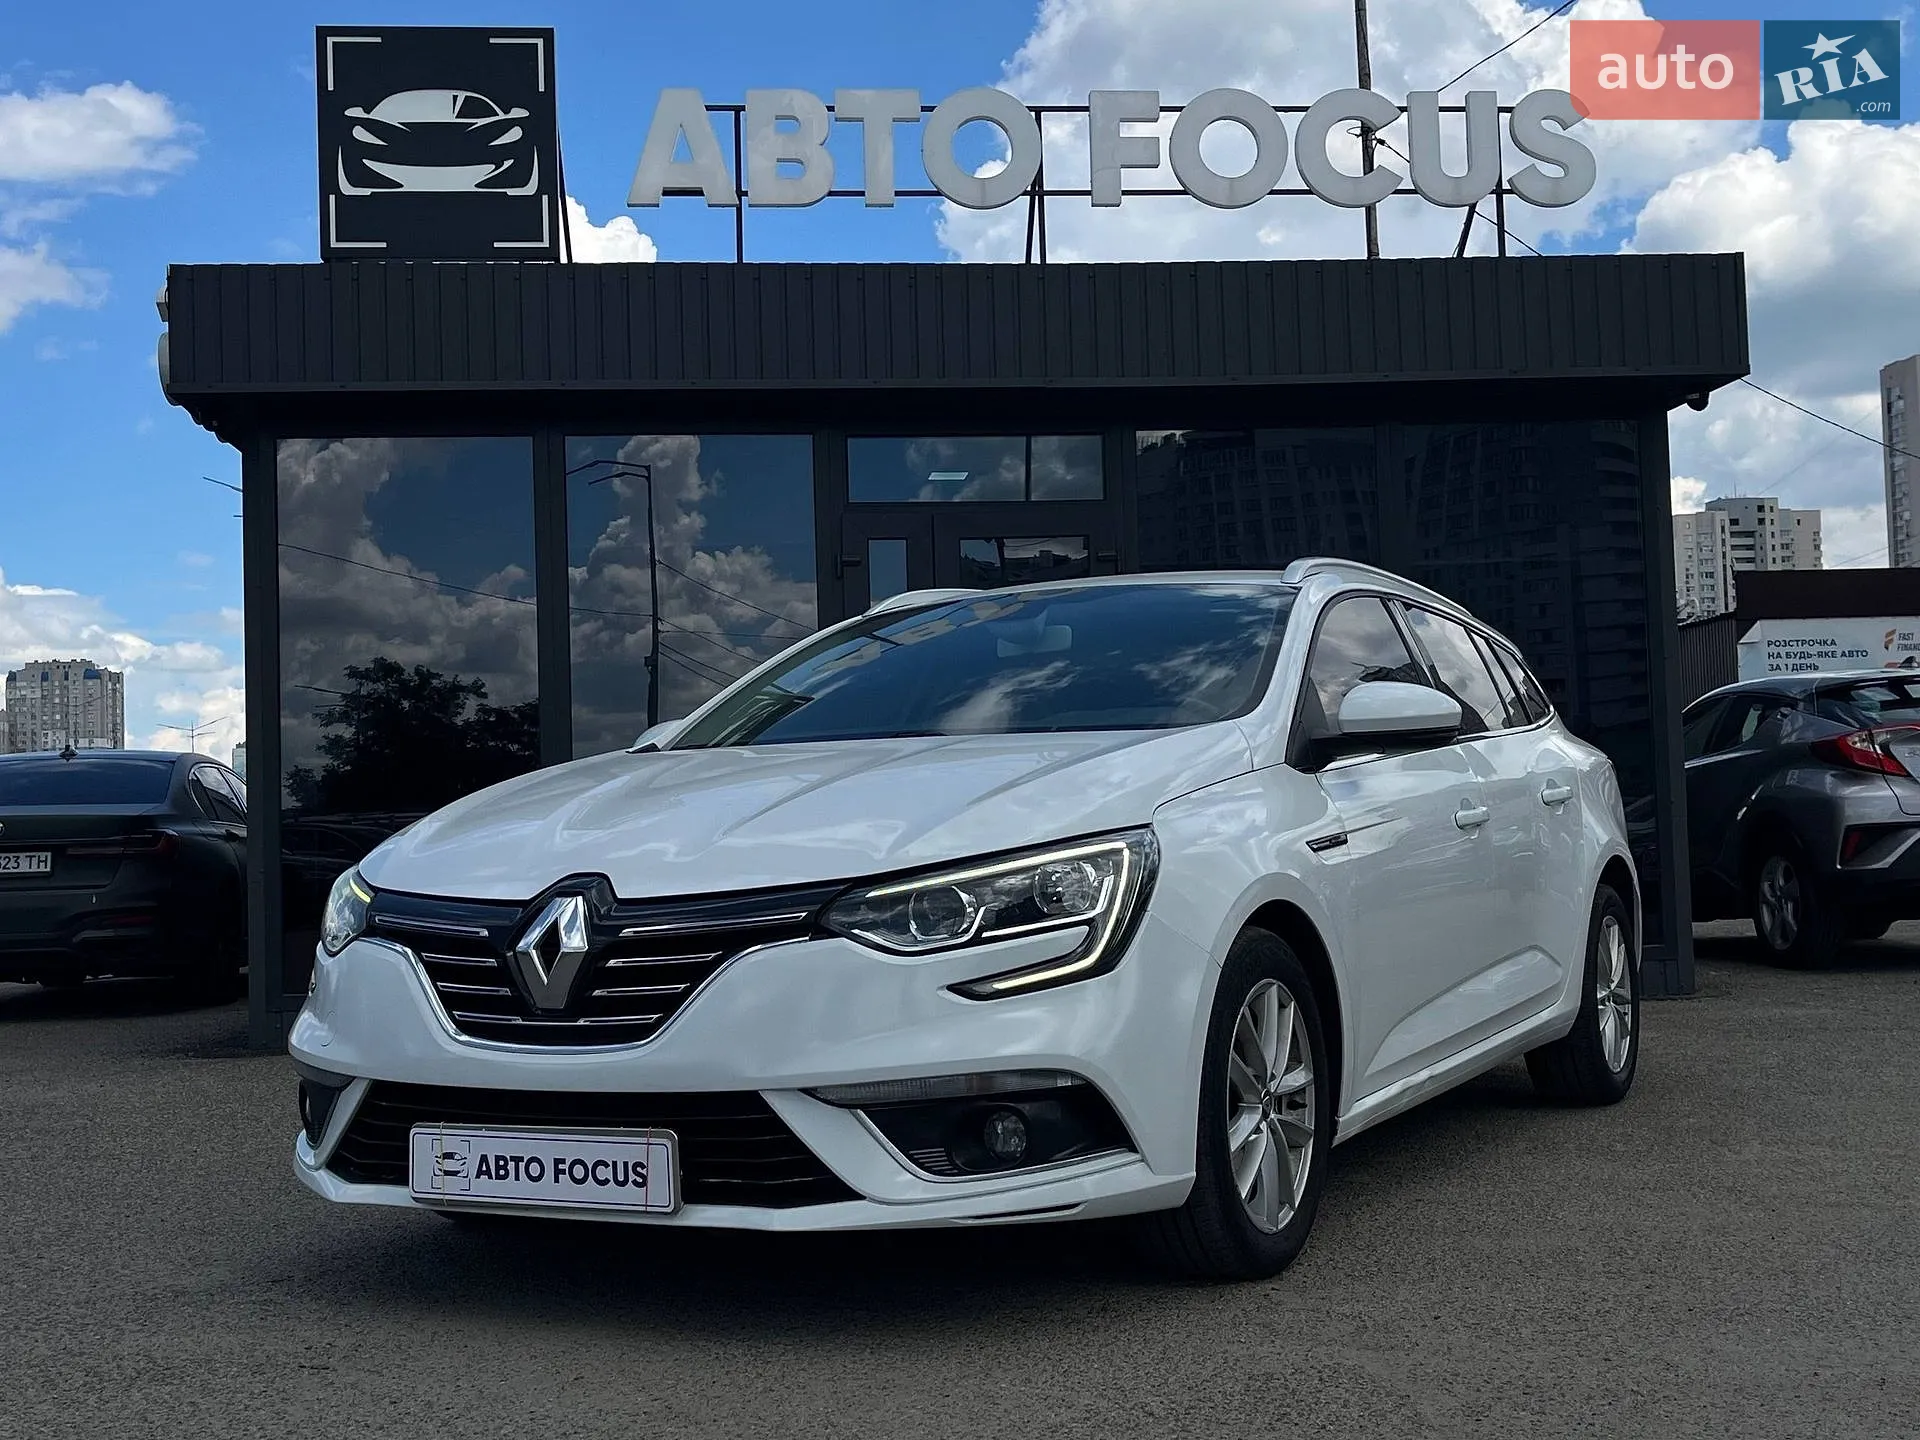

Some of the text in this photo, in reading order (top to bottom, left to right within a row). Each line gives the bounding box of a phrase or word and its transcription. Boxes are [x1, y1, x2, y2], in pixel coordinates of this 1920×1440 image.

[627, 87, 1597, 210] АВТО FOCUS
[1767, 639, 1838, 648] РОЗСТРОЧКА
[1767, 650, 1869, 660] НА БУДЬ-ЯКЕ АВТО
[1768, 663, 1820, 672] ЗА 1 ДЕНЬ
[0, 854, 48, 870] 23 TH
[474, 1153, 648, 1188] АВТО FOCUS
